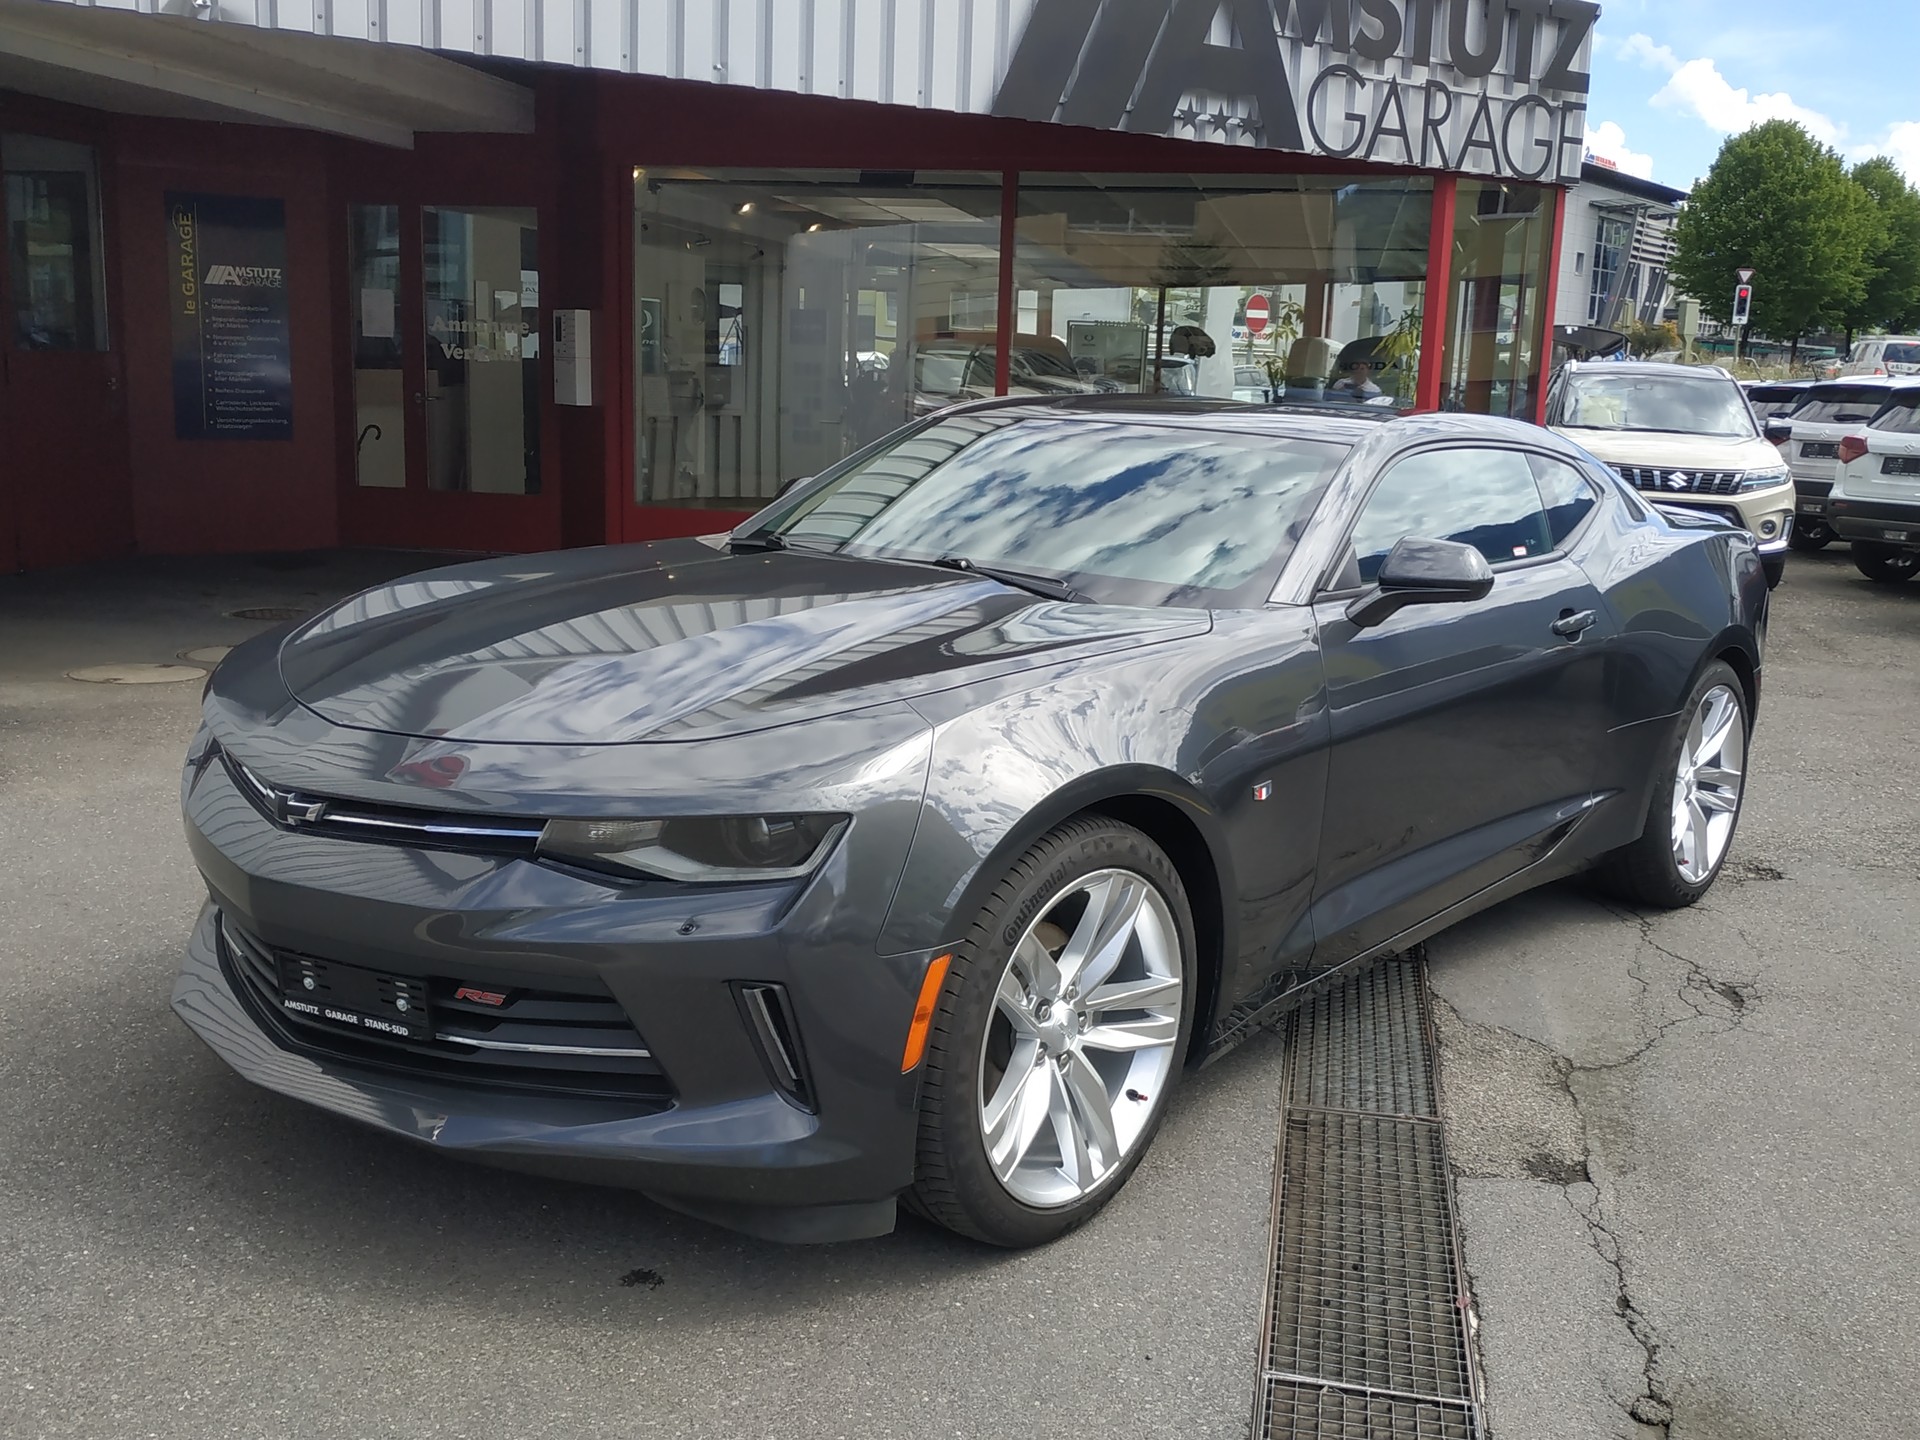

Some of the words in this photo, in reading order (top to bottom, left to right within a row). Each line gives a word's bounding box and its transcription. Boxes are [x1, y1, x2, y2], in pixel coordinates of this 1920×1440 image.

[1307, 64, 1587, 184] GARAGE
[180, 212, 195, 299] GARAGE
[220, 265, 281, 286] AMSTUTZ
[240, 277, 282, 288] GARAGE
[184, 301, 195, 315] le
[1002, 868, 1066, 947] Continental
[454, 987, 506, 1006] RS
[284, 1000, 320, 1015] AMSTUTZ
[325, 1009, 359, 1025] GARAGE
[364, 1018, 409, 1036] STANS-SÜD
